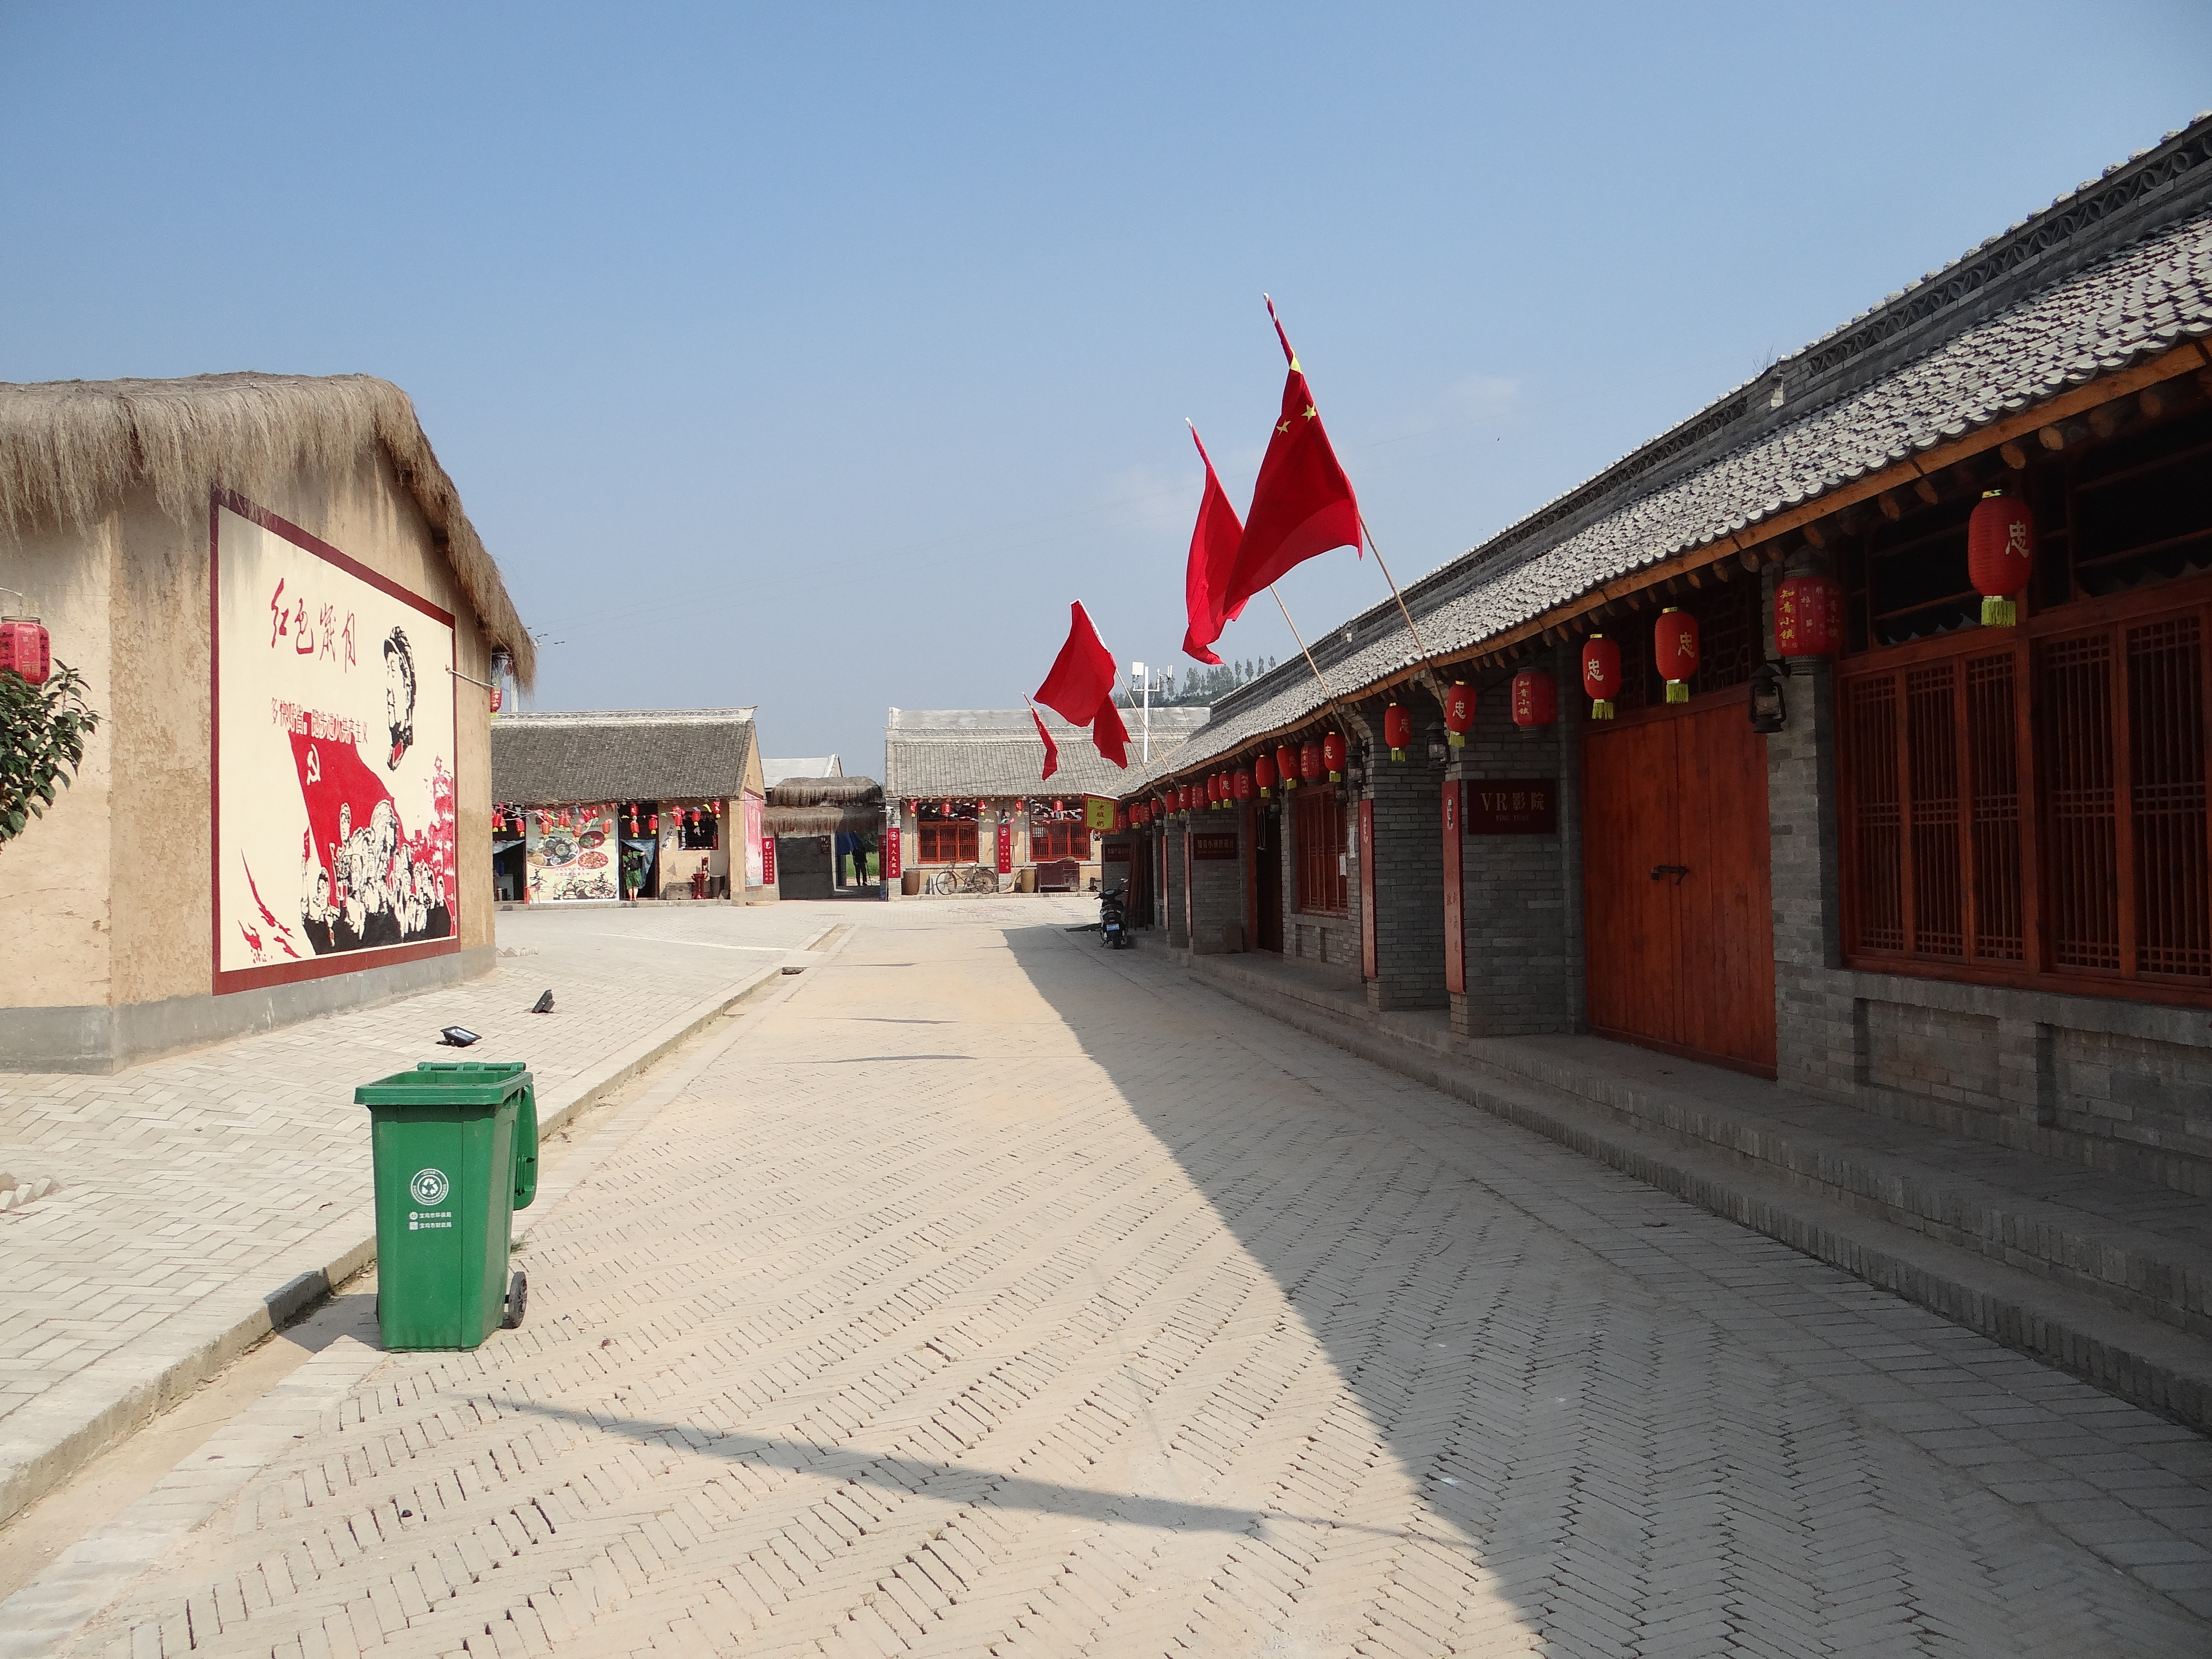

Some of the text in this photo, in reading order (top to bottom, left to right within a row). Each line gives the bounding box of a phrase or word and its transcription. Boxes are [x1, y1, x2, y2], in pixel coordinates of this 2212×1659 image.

[2005, 520, 2029, 558] 忠
[1779, 589, 1795, 639] 知青小镇
[1678, 631, 1695, 658] 忠
[1587, 658, 1604, 682] 忠
[1517, 680, 1530, 715] 知青小镇
[1452, 700, 1467, 720] 忠
[1399, 717, 1410, 735] 忠
[1324, 745, 1333, 759] 忠
[1222, 779, 1231, 791] 忠
[1096, 804, 1106, 827] 老酸奶
